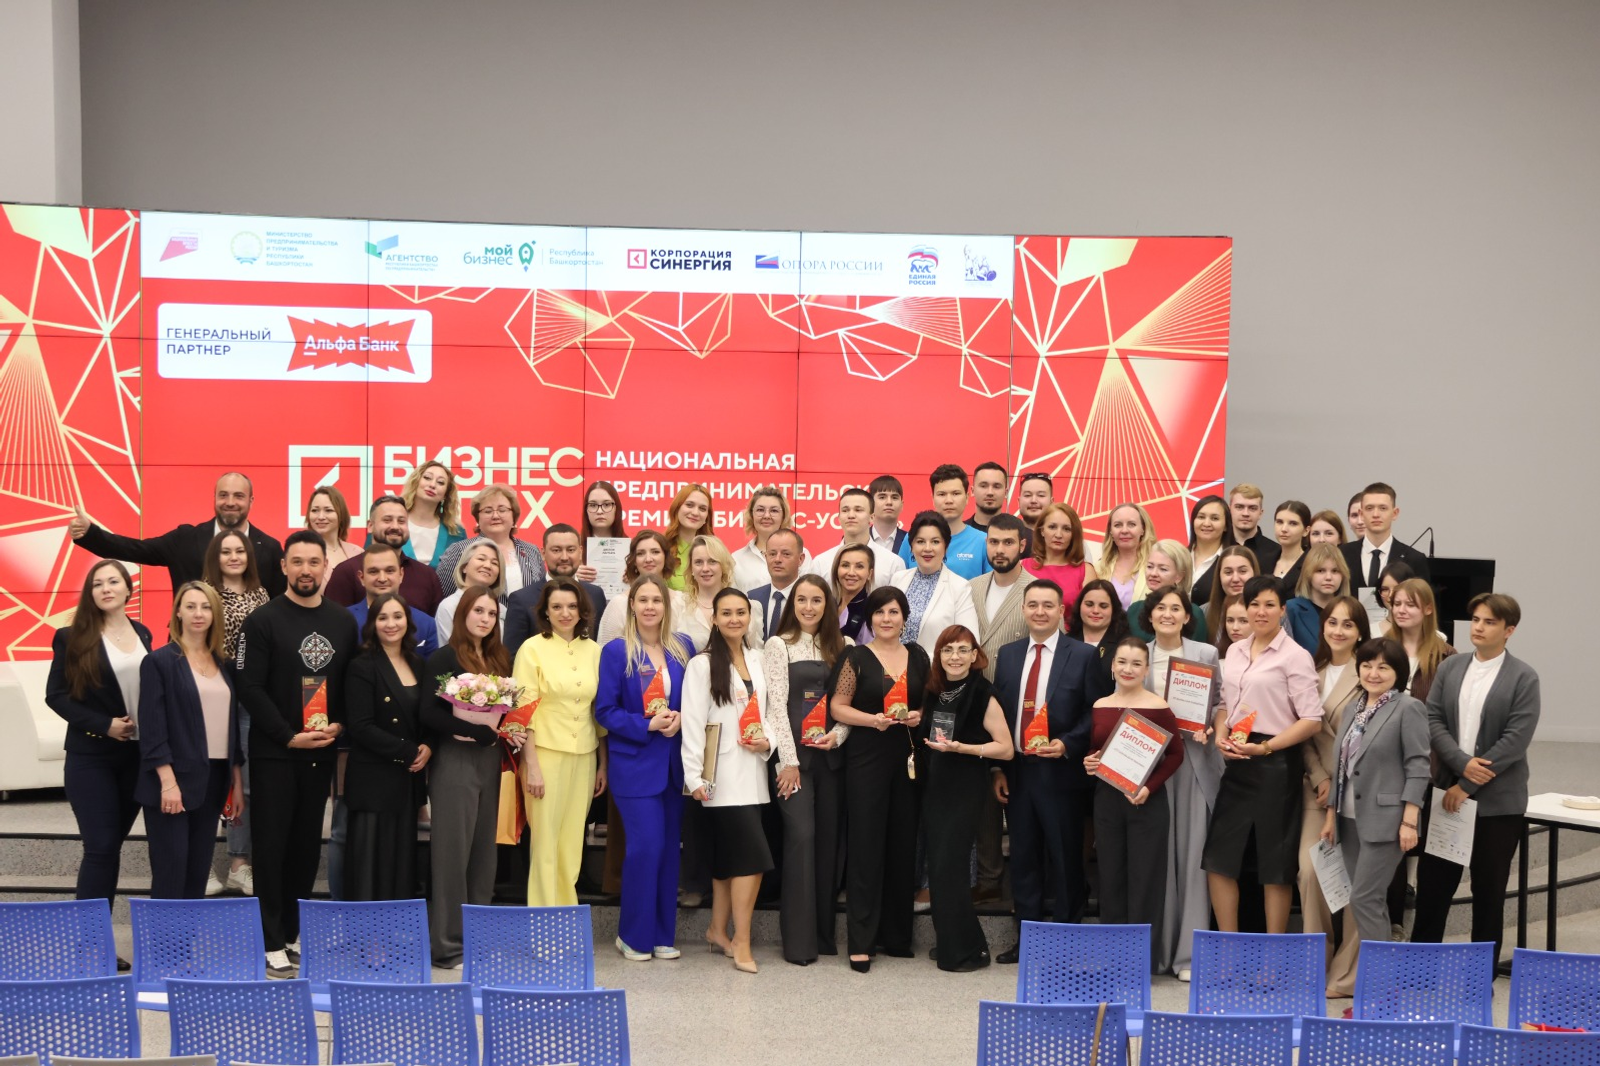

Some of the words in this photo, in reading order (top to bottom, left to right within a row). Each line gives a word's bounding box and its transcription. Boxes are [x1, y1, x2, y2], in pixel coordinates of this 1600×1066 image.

[484, 244, 513, 256] мой
[549, 248, 595, 258] Республика
[651, 249, 732, 259] КОРПОРАЦИЯ
[385, 254, 439, 263] АГЕНТСТВО
[463, 251, 513, 266] бизнес
[549, 257, 604, 266] Башкортостан
[650, 258, 732, 271] СИНЕРГИЯ
[781, 259, 827, 271] ОПОРА
[830, 260, 883, 272] РОССИИ
[167, 327, 271, 341] ГЕНЕРАЛЬНЫЙ
[167, 343, 232, 356] ПАРТНЕР
[303, 335, 357, 355] Альфа
[359, 336, 400, 352] Банк
[383, 445, 585, 487] БИЗНЕС
[596, 450, 796, 472] НАЦИОНАЛЬНАЯ
[1172, 677, 1208, 690] ДИПЛОМ
[1119, 730, 1156, 755] ДИПЛОМ
